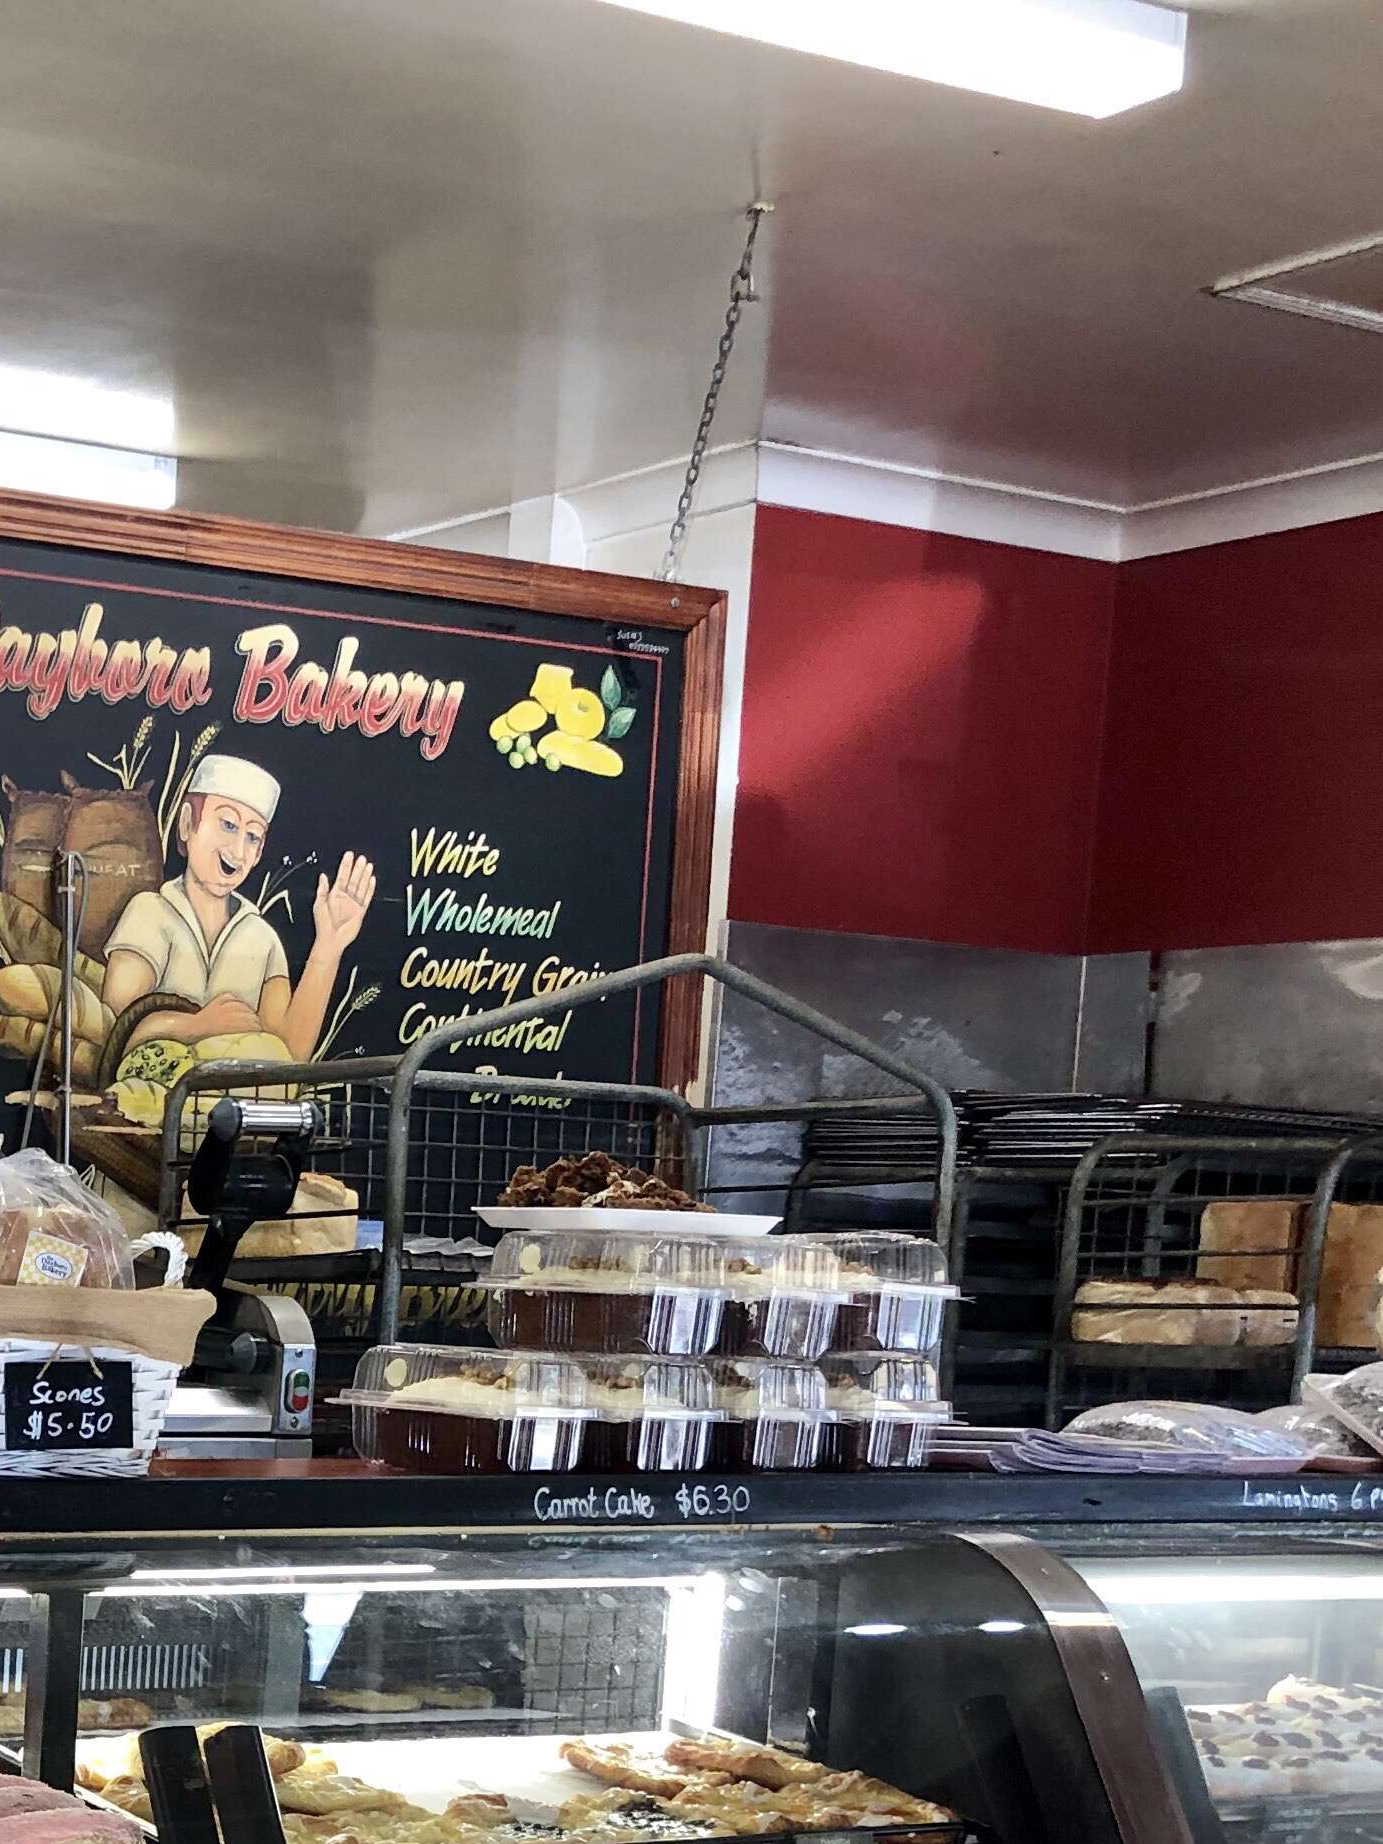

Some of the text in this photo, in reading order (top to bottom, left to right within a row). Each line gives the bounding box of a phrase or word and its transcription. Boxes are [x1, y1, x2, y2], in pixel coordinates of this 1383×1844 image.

[233, 622, 467, 762] Bakery
[410, 826, 500, 878] White
[406, 884, 561, 938] Wholemeal
[400, 946, 526, 1008] Country
[30, 1381, 106, 1407] Scones
[23, 1409, 113, 1441] $5.50
[534, 1484, 751, 1520] Carrot Cake $6.30
[1351, 1481, 1363, 1509] 6
